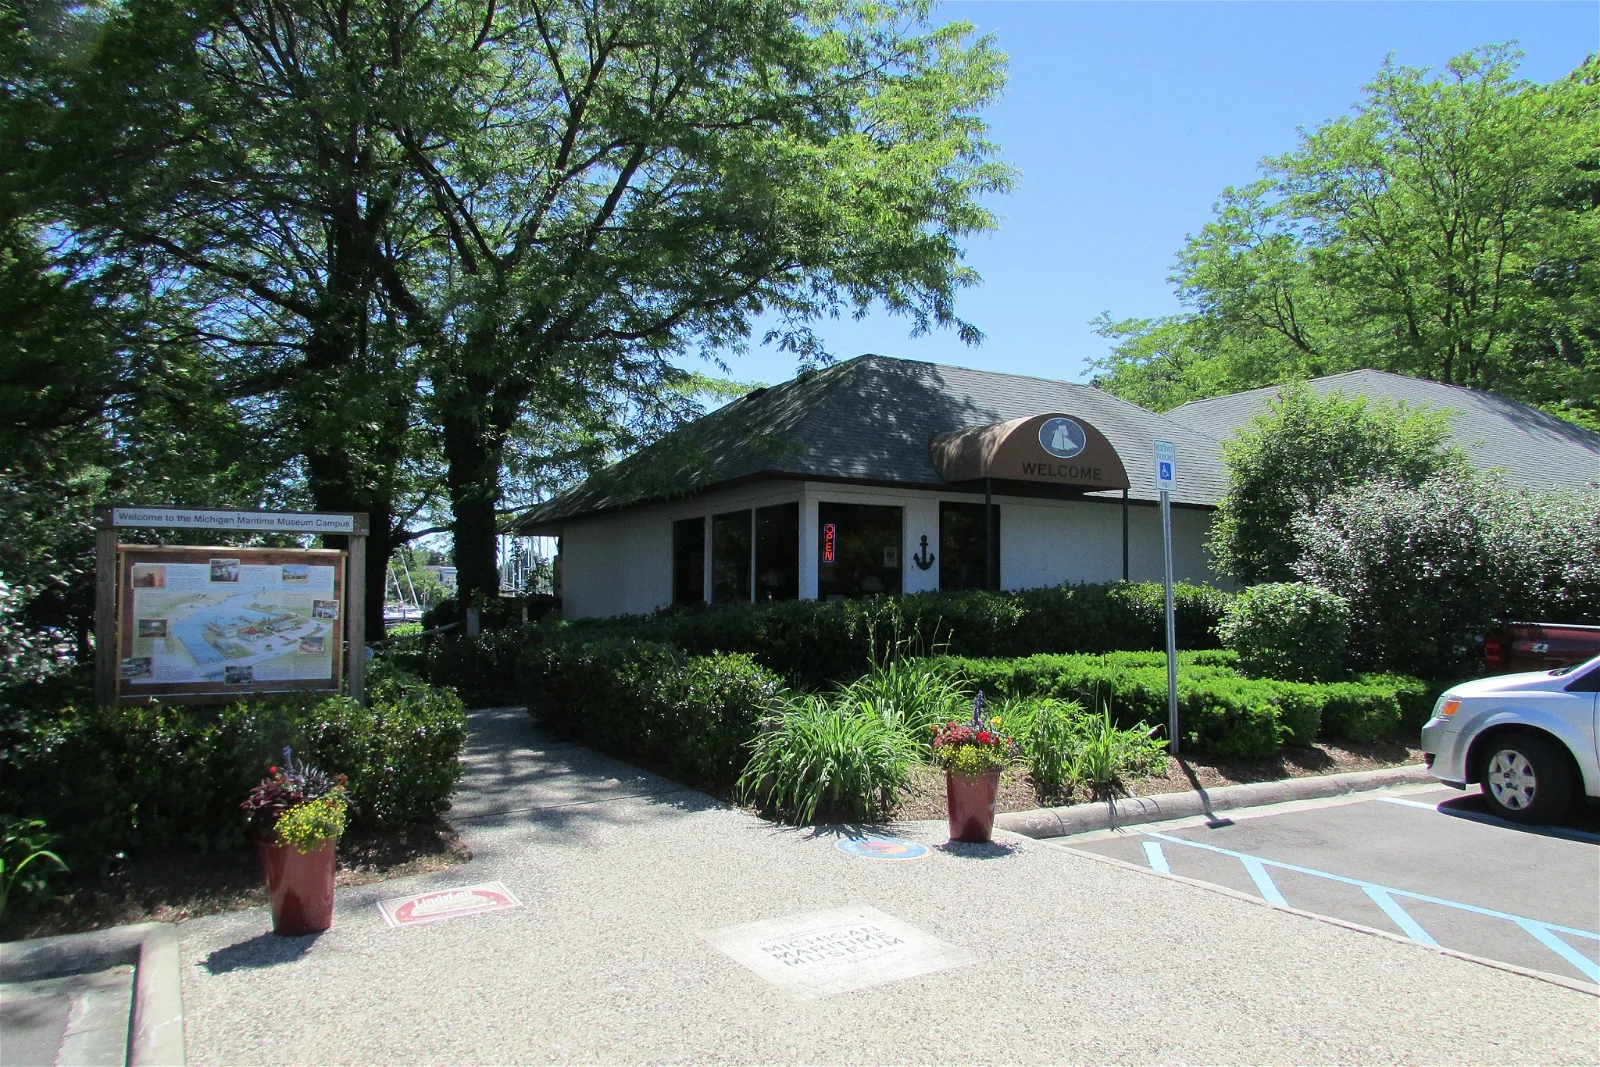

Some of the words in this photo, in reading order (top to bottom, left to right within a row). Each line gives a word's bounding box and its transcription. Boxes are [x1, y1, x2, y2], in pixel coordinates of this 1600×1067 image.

[1022, 462, 1102, 480] WELCOME
[119, 512, 163, 523] Welcome
[165, 514, 174, 523] to
[177, 514, 191, 523] the
[194, 514, 234, 525] Michigan
[237, 515, 275, 525] Maritime
[277, 517, 314, 526] Museum
[316, 518, 350, 529] Campus
[824, 525, 834, 561] OPEN
[761, 925, 880, 953] MICHIGAN
[772, 934, 893, 960] MARITIME
[783, 937, 906, 968] MUSEUM
